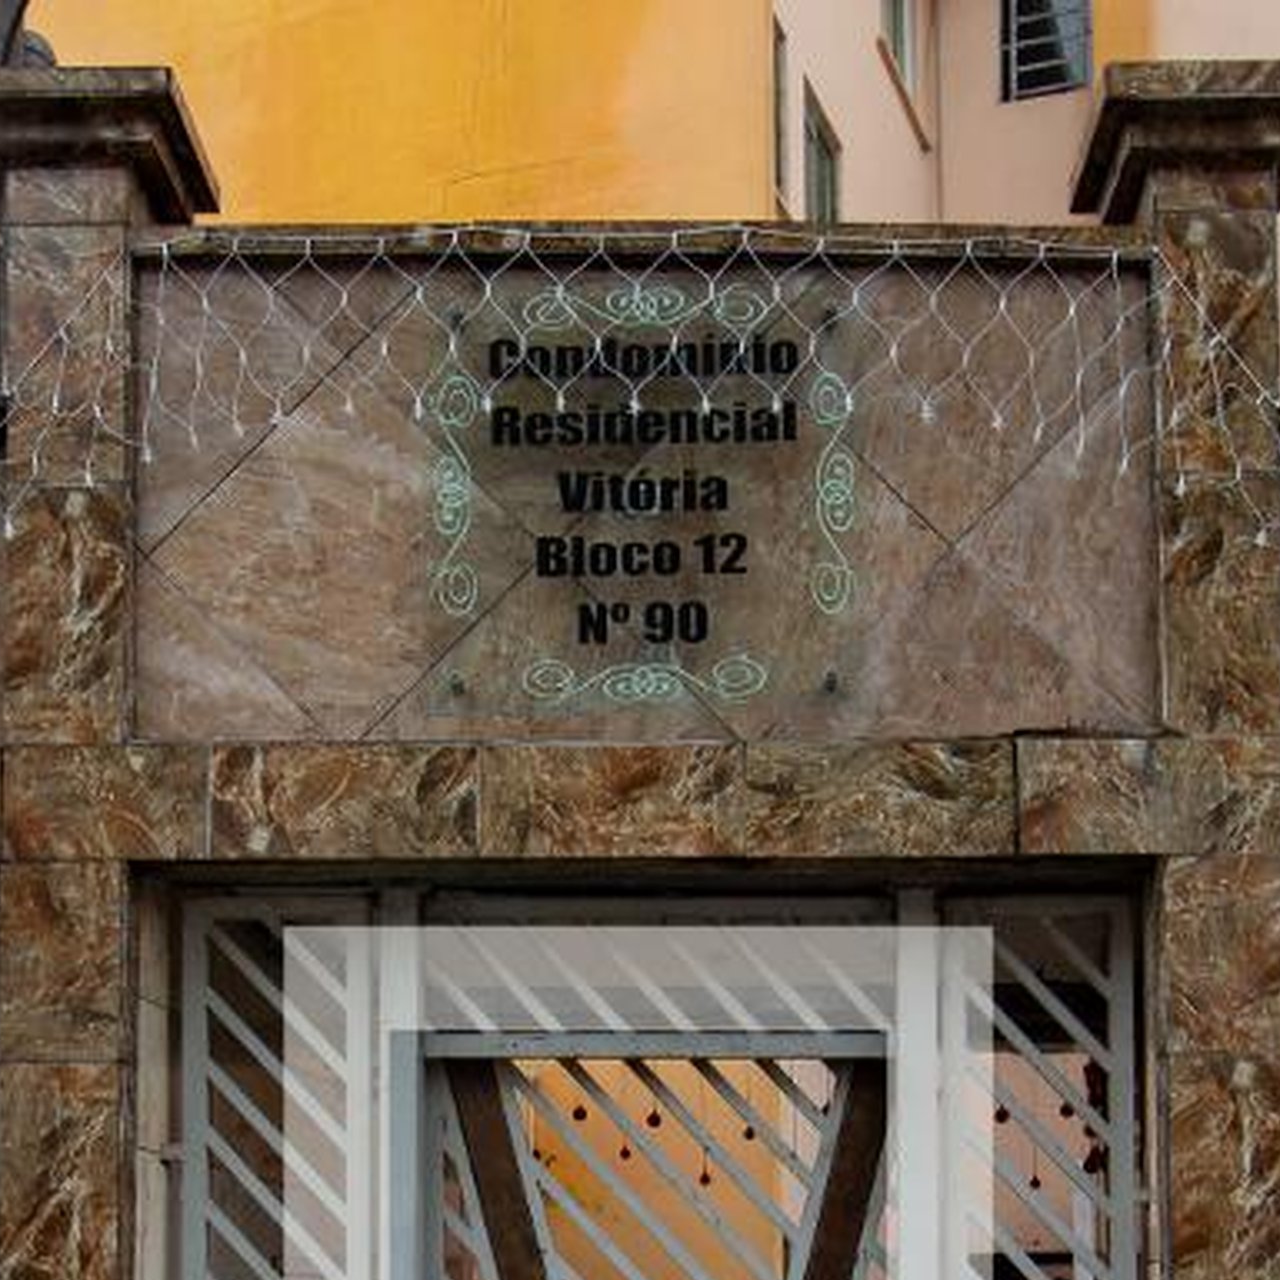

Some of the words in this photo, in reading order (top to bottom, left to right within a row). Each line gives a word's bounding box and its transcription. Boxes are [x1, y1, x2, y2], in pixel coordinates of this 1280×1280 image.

[490, 400, 798, 446] Residencial
[557, 469, 728, 513] Vitória
[535, 535, 681, 578] Bloco
[694, 533, 748, 575] 12
[644, 601, 709, 644] 90
